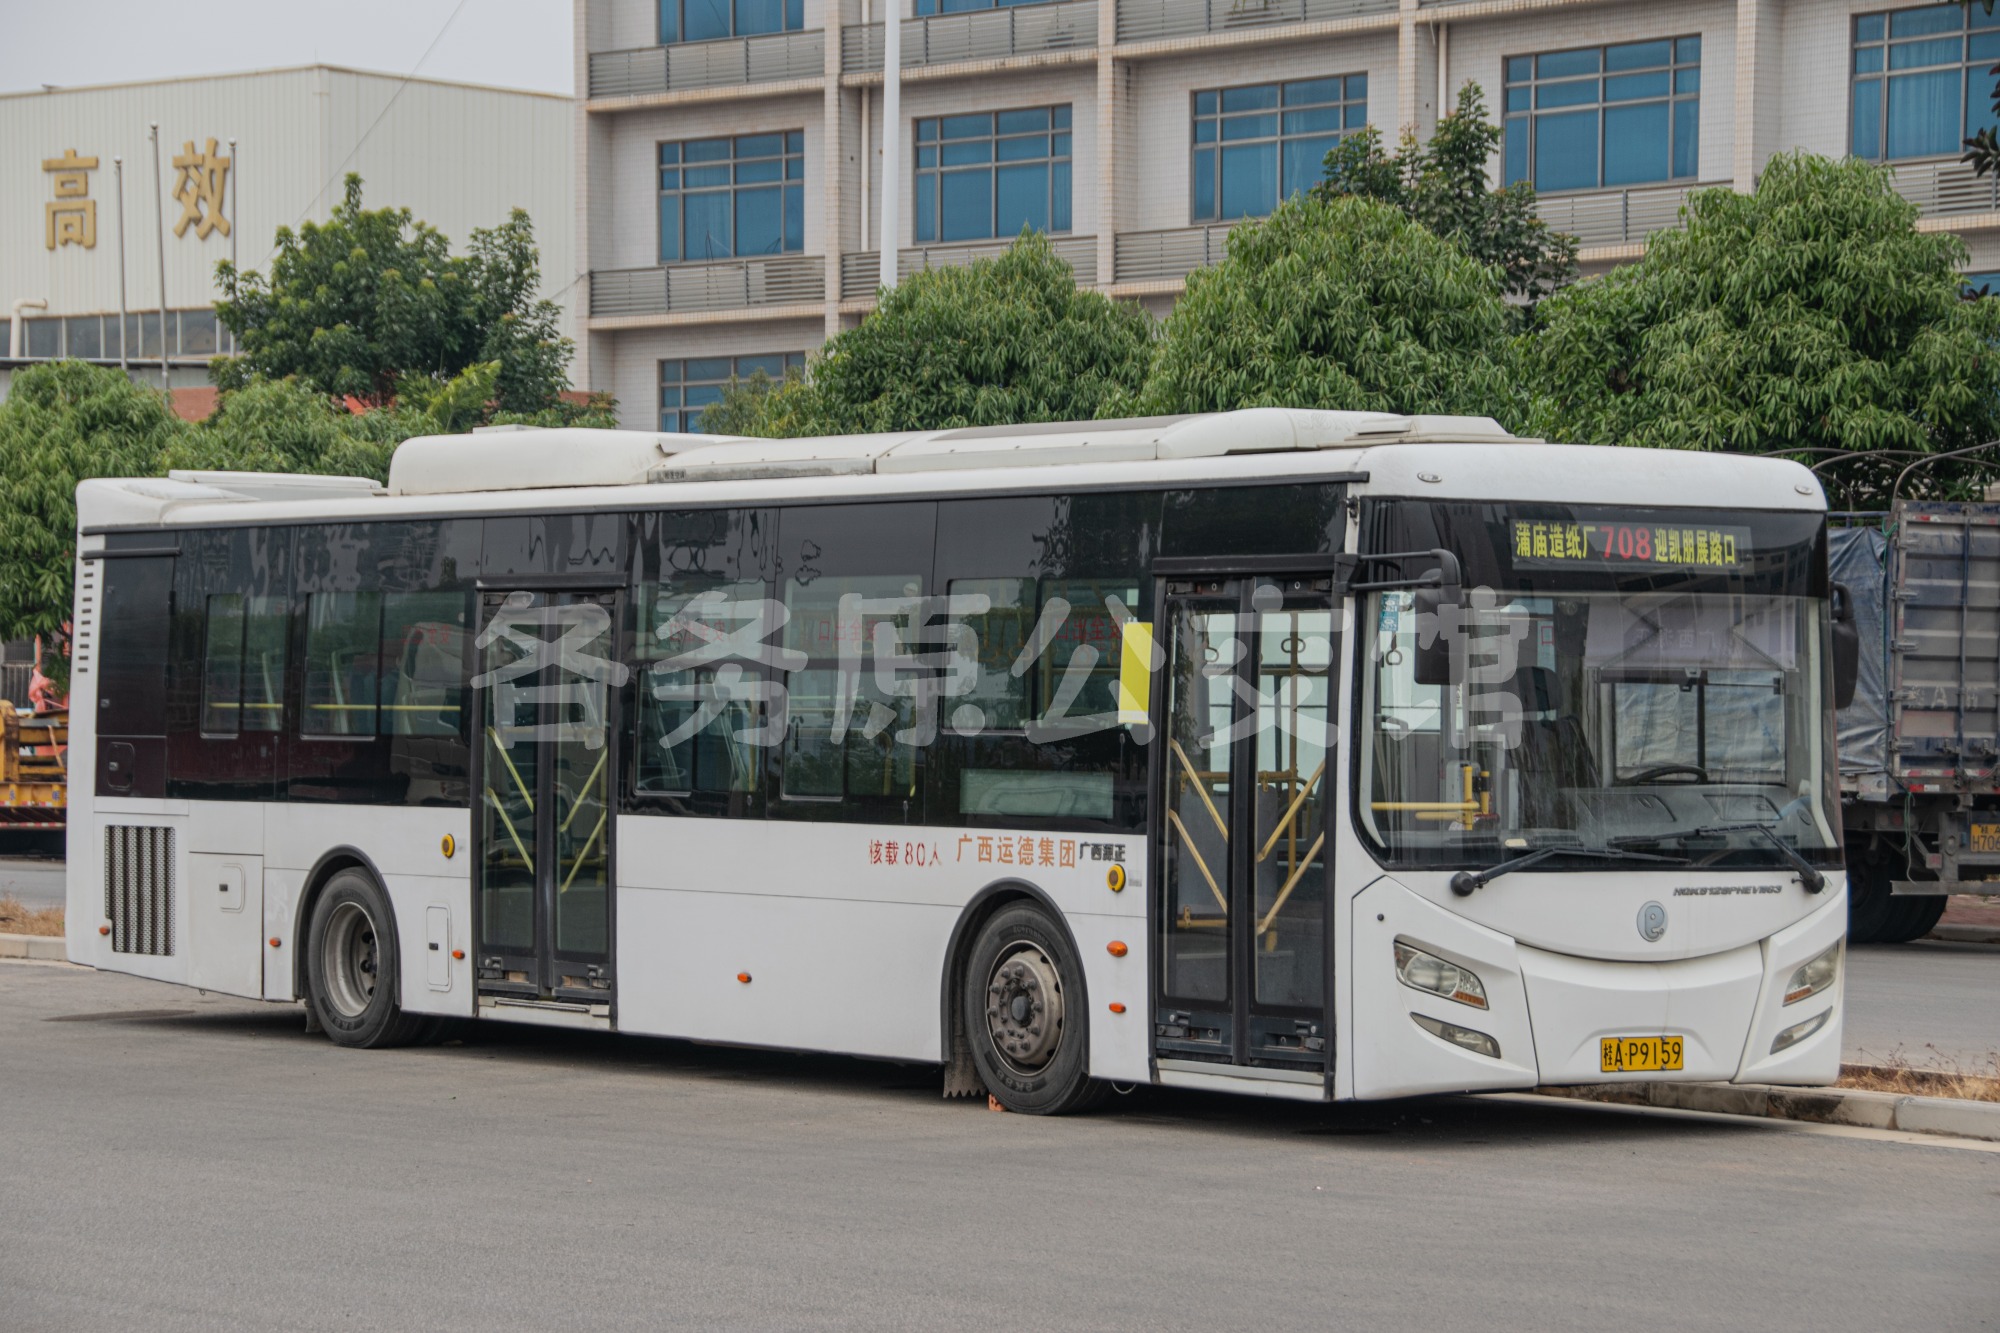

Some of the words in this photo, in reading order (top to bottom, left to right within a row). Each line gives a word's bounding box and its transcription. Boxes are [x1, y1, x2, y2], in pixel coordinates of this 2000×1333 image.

[42, 136, 231, 251] 高效
[1515, 521, 1597, 560] 蒲庙造纸厂
[1600, 526, 1651, 560] 708
[1654, 527, 1736, 566] 迎凯朋展路口
[957, 834, 1076, 868] 广西运德集团
